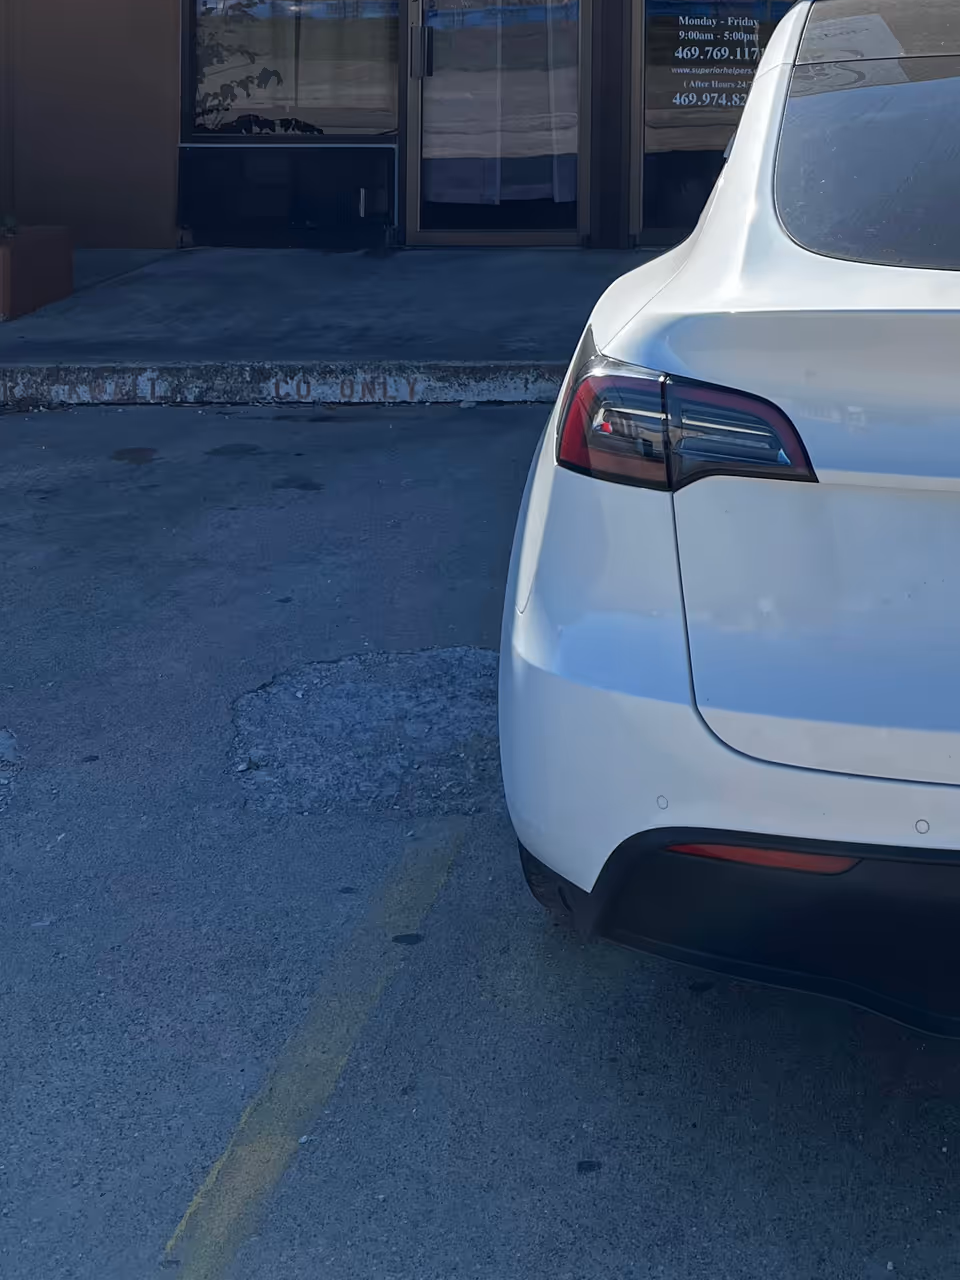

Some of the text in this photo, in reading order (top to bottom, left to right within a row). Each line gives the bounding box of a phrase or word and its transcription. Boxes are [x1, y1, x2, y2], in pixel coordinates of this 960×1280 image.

[678, 16, 717, 27] Monday
[727, 16, 760, 28] Friday
[678, 30, 714, 40] 9:00am
[723, 31, 759, 42] 5:00pm
